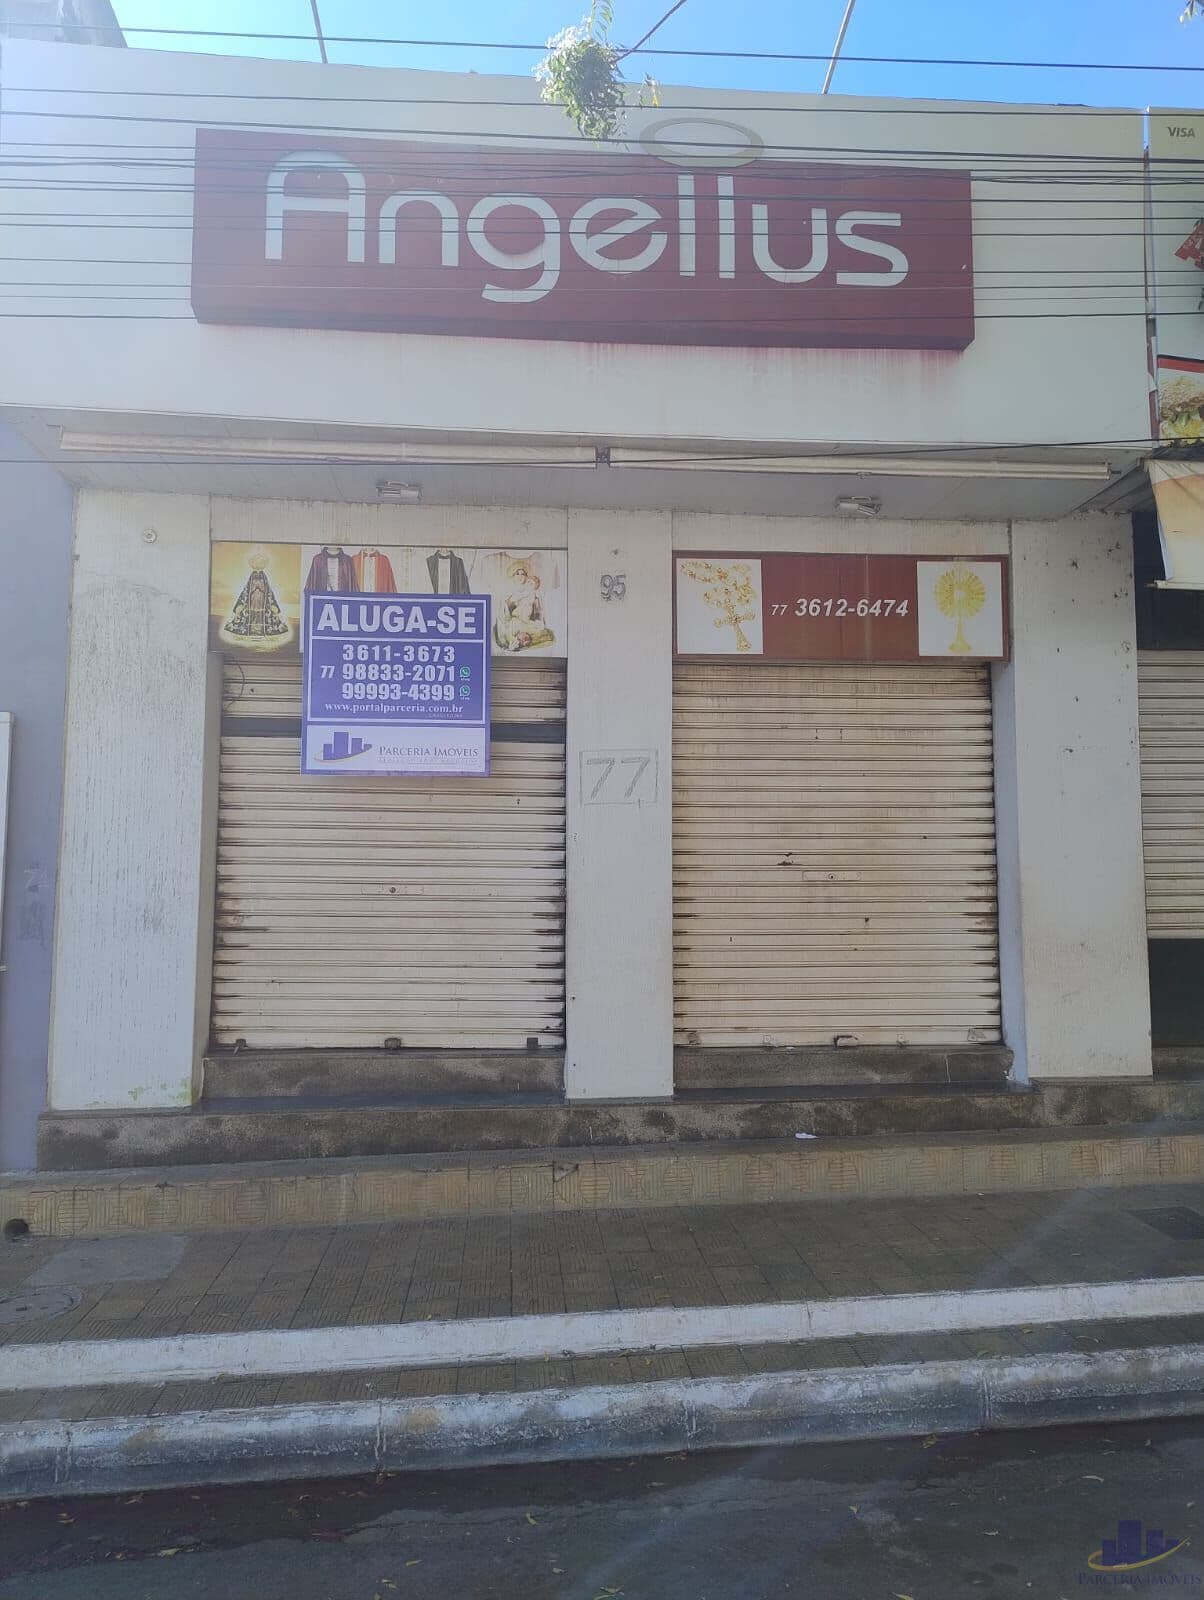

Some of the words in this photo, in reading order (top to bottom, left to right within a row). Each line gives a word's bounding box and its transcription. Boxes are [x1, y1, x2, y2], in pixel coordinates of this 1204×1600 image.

[1167, 126, 1196, 138] VISA
[264, 151, 910, 304] Angellus
[600, 574, 627, 600] 95
[771, 604, 787, 616] 77
[795, 598, 909, 618] 3612-6474
[316, 603, 477, 634] ALUGA-SE
[342, 644, 456, 663] 3611-3673
[320, 665, 335, 679] 77
[342, 663, 455, 682] 98833-2071
[342, 682, 455, 701] 99993-4399
[325, 703, 463, 714] www.portalparceria.com.br
[379, 746, 431, 756] PARCERIA
[586, 757, 650, 800] 77
